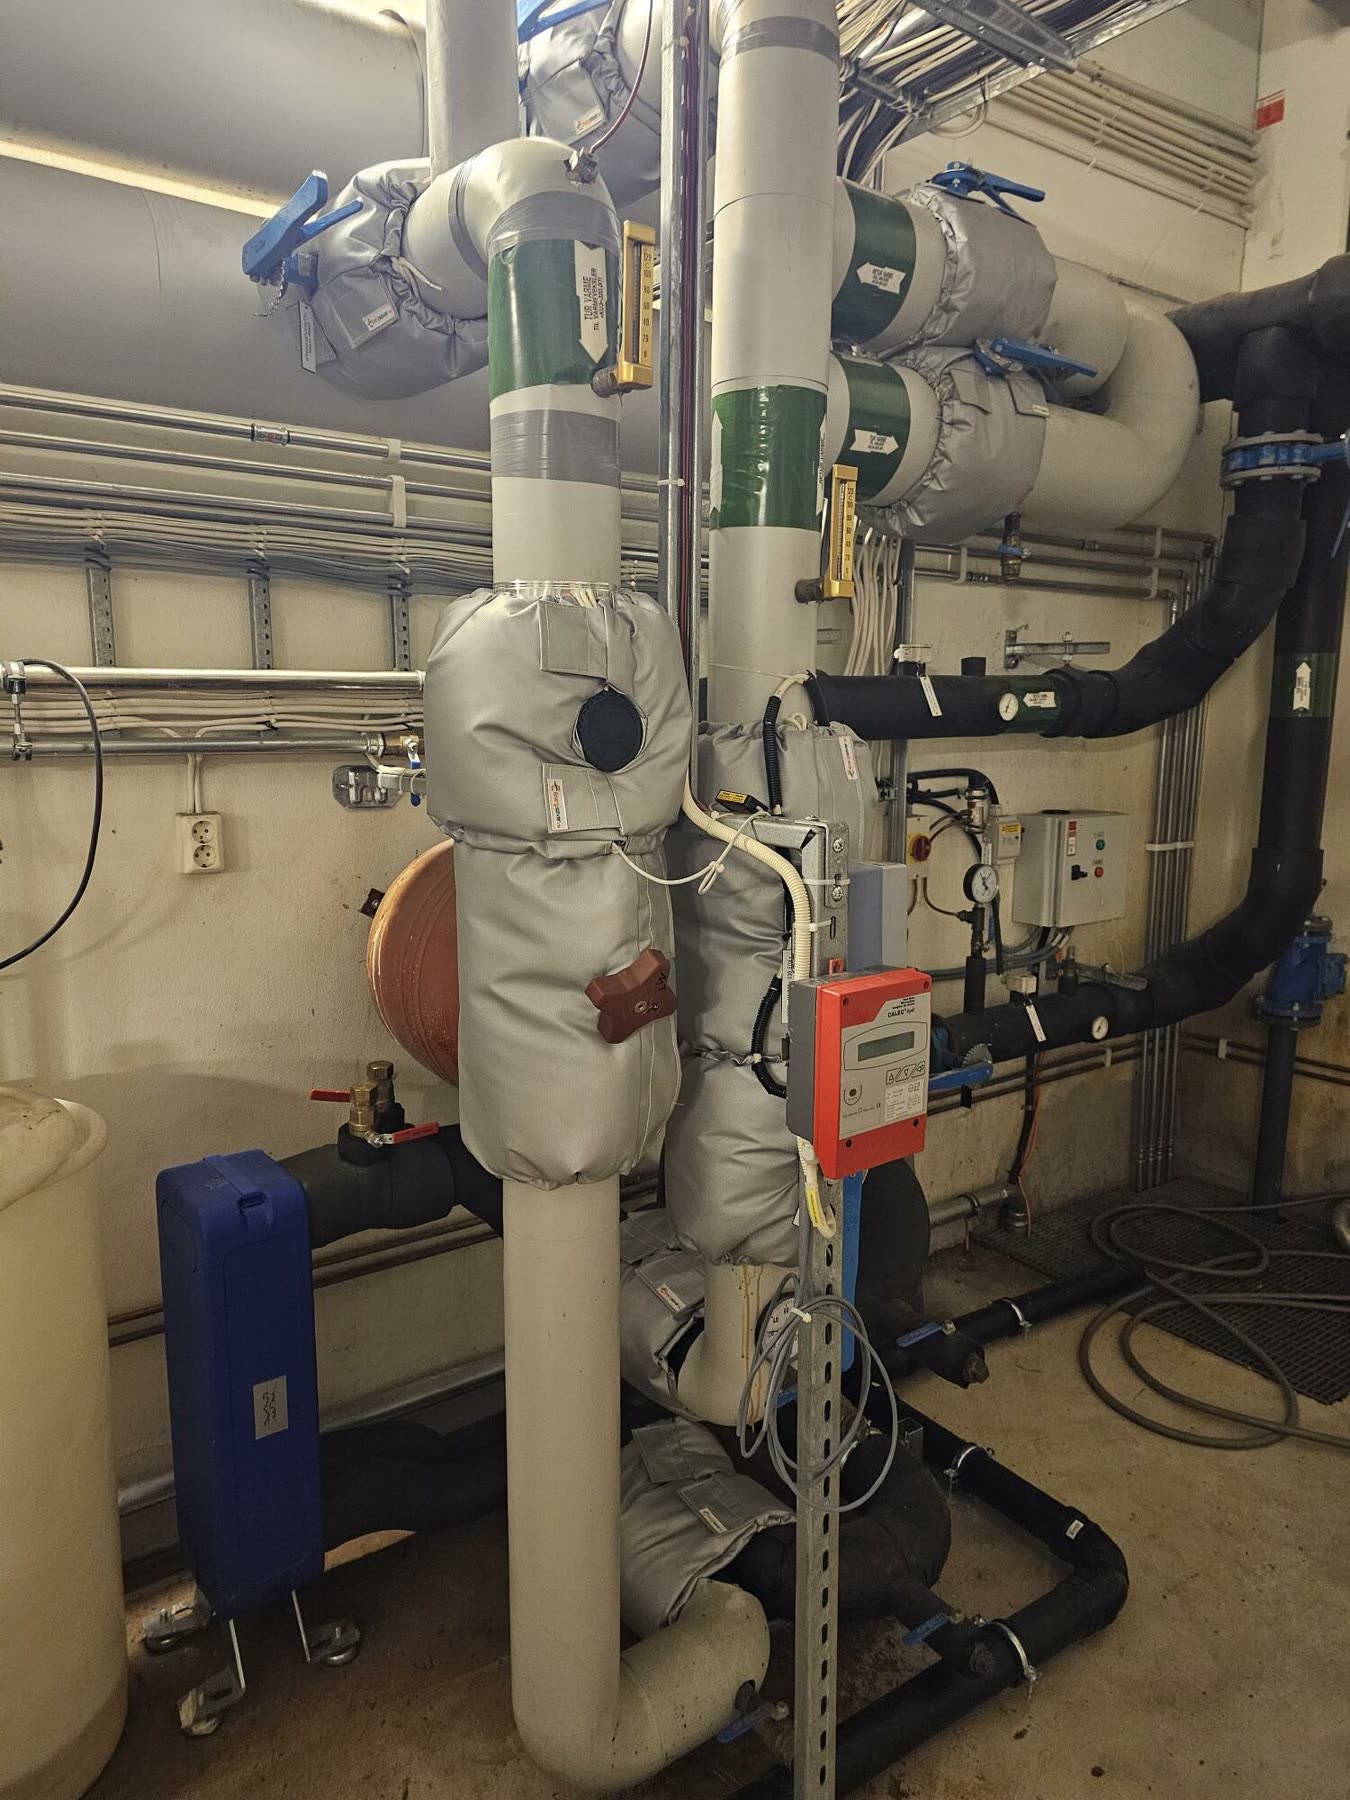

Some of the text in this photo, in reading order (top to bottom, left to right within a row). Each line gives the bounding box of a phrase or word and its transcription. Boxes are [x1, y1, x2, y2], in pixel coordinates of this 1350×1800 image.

[582, 276, 593, 321] TUR VARME
[642, 318, 650, 327] 40
[642, 334, 649, 342] 20
